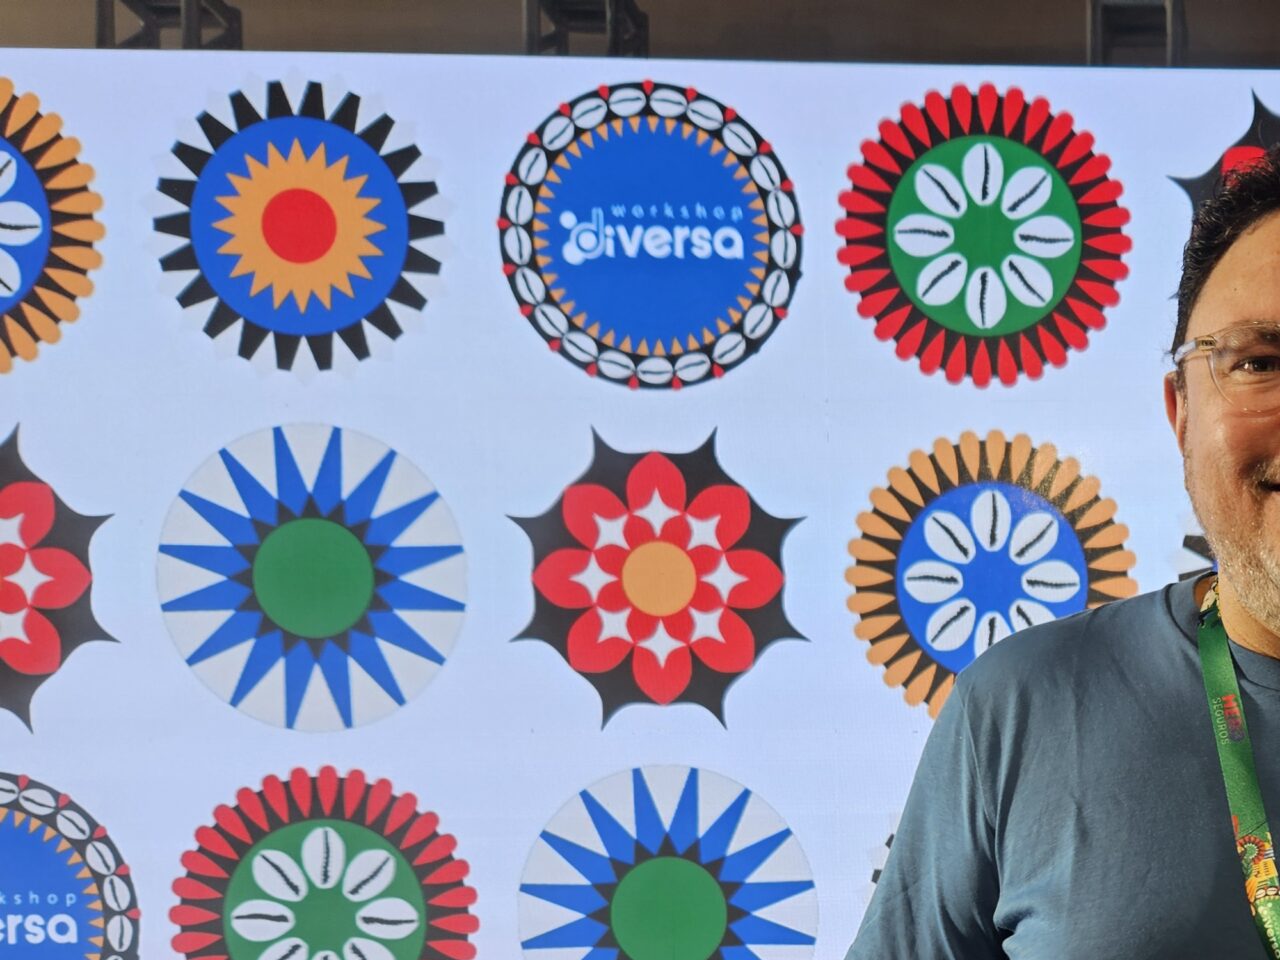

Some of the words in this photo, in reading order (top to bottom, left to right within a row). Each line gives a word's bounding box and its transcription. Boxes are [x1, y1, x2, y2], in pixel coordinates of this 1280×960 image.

[559, 206, 745, 266] diversa
[610, 202, 744, 223] workshop
[1212, 697, 1229, 745] SEGUROS
